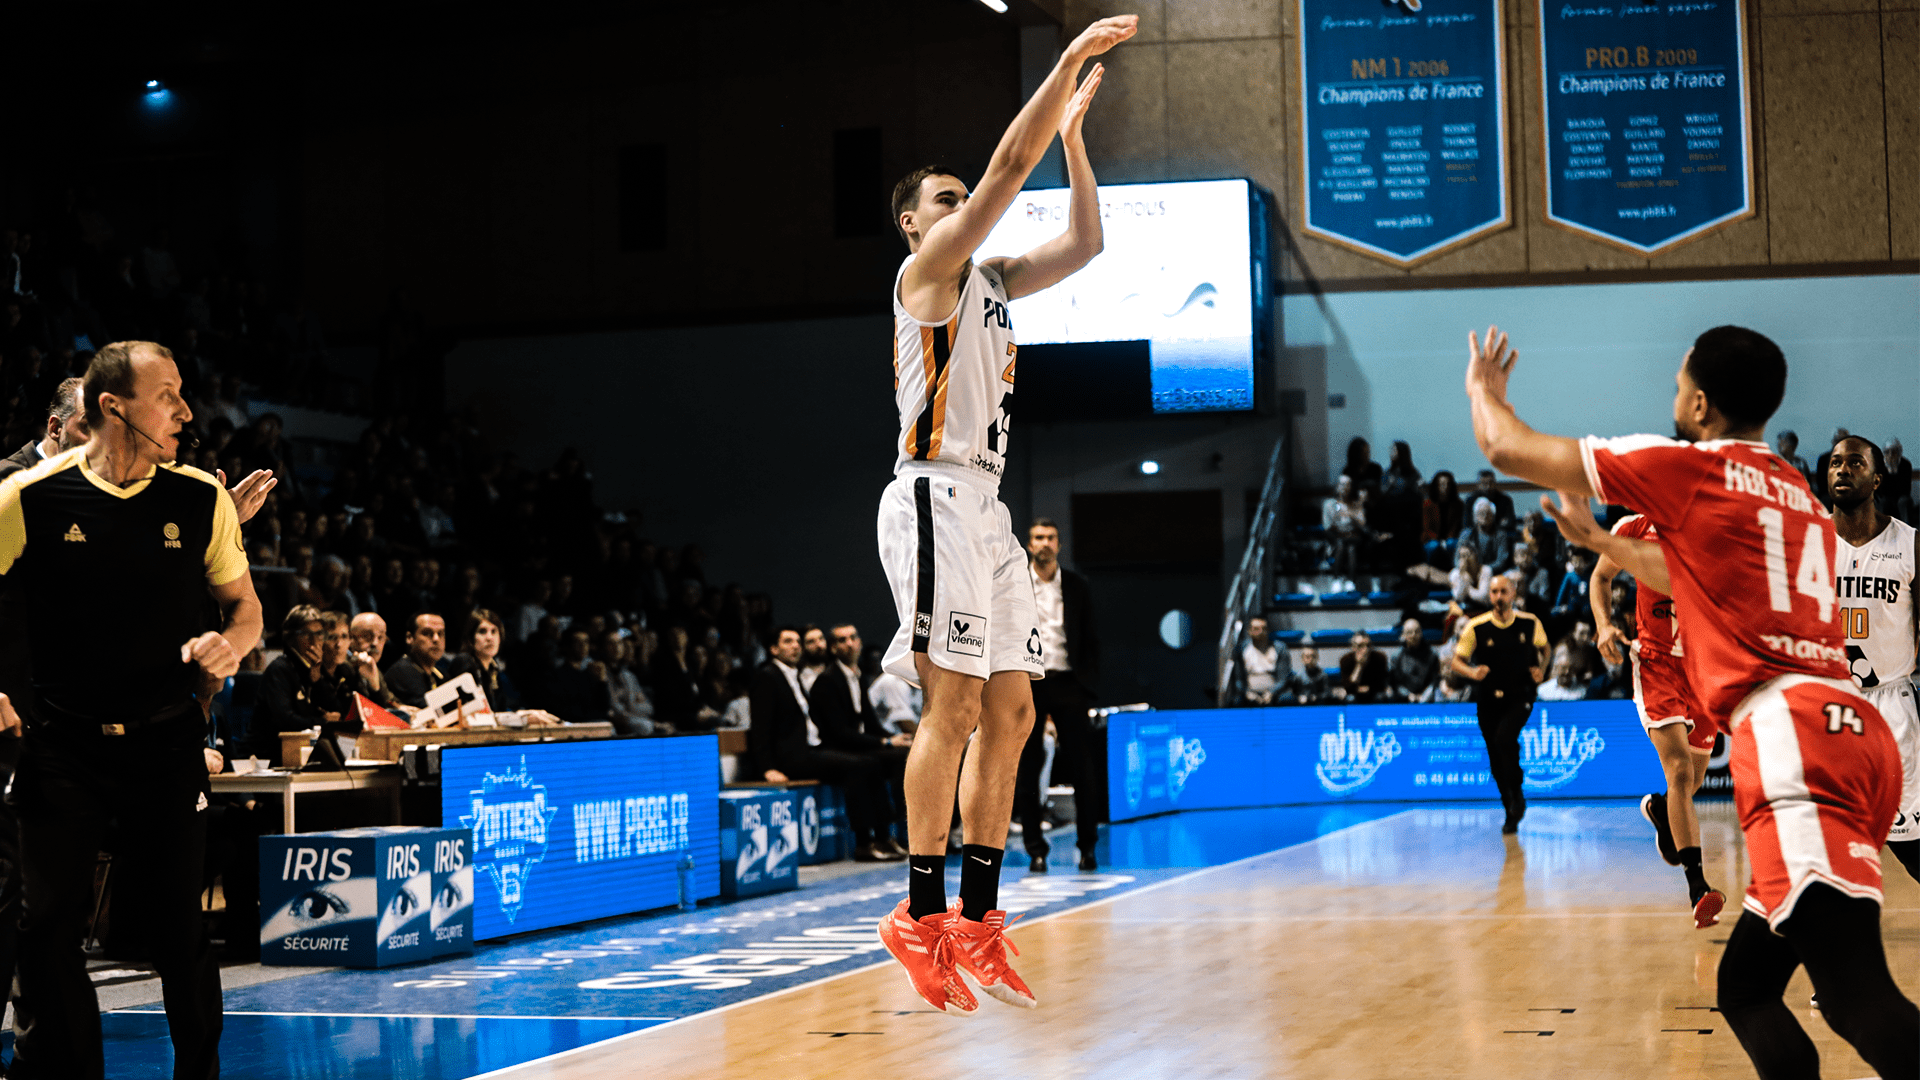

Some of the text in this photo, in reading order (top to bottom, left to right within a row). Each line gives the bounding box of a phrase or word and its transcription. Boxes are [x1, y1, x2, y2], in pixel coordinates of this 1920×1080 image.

[1351, 57, 1450, 79] NM 1 2006
[1586, 46, 1698, 68] PRO.B 2009
[1318, 79, 1484, 107] Champions de France
[1559, 70, 1726, 96] Champions de France
[1682, 126, 1723, 137] YOUNGER
[1685, 113, 1719, 124] WRIGHT
[1724, 458, 1814, 515] HOLTON
[1757, 506, 1837, 624] 14
[1837, 576, 1900, 603] ITIERS
[1840, 607, 1869, 639] 10
[951, 634, 982, 648] vienne
[1823, 702, 1864, 736] 14
[472, 793, 546, 854] POITIERS
[282, 847, 353, 881] IRIS
[386, 844, 421, 880] IRIS
[434, 838, 465, 874] IRIS
[283, 935, 350, 951] SÉCURITÉ
[577, 916, 895, 991] OITIERS
